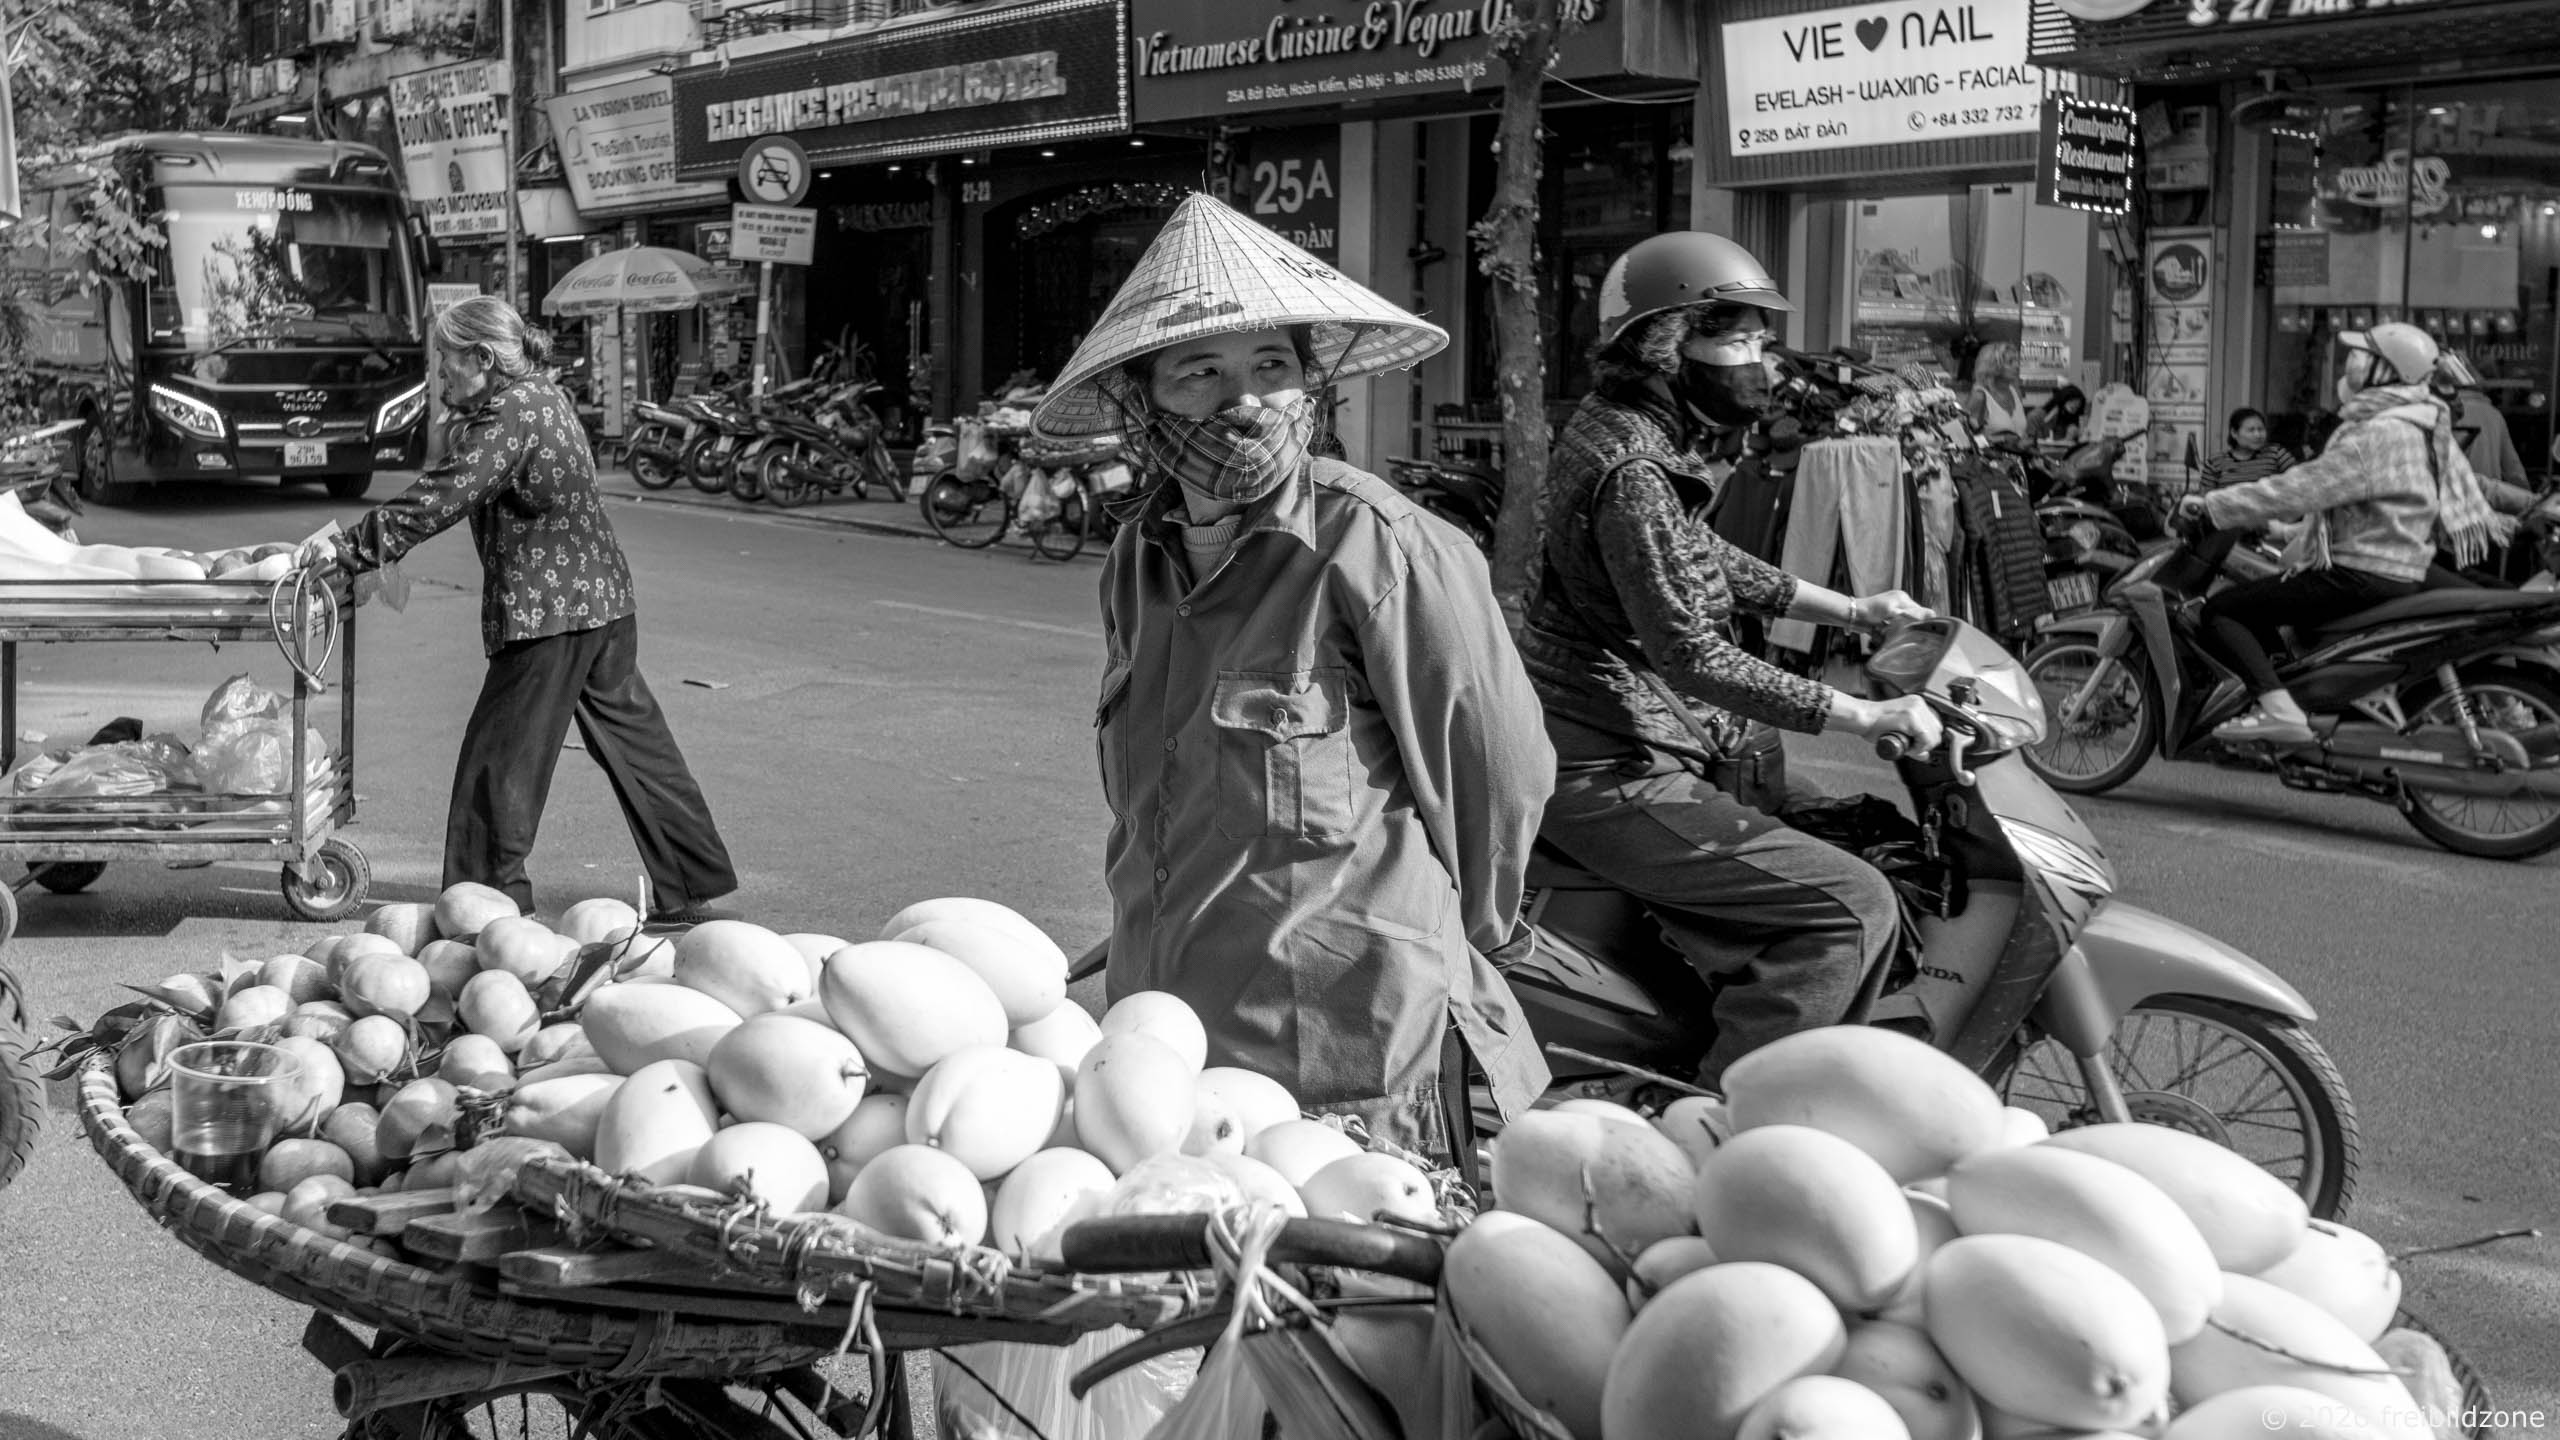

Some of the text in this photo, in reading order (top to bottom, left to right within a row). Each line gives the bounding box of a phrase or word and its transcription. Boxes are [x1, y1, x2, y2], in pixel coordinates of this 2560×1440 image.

[1136, 32, 1261, 77] Vietnamese
[1265, 14, 1357, 62] Cuisine
[1360, 2, 1389, 50] &
[1391, 0, 1475, 57] Vegan
[1783, 5, 1993, 62] VIE NAIL
[1755, 84, 1843, 113] EYELASH
[1859, 73, 1940, 102] WAXING
[1959, 64, 2036, 91] FACIAL
[399, 100, 498, 147] BOOKING OFFICE
[706, 86, 826, 142] ELEGANCE
[1961, 109, 1989, 125] 332
[1995, 104, 2023, 122] 732
[2064, 108, 2129, 146] Countryside
[1754, 128, 1779, 143] 25B
[2060, 139, 2127, 174] Restaurant
[587, 165, 648, 190] BOOKING
[1253, 158, 1335, 215] 25A
[1920, 965, 1967, 985] NDA
